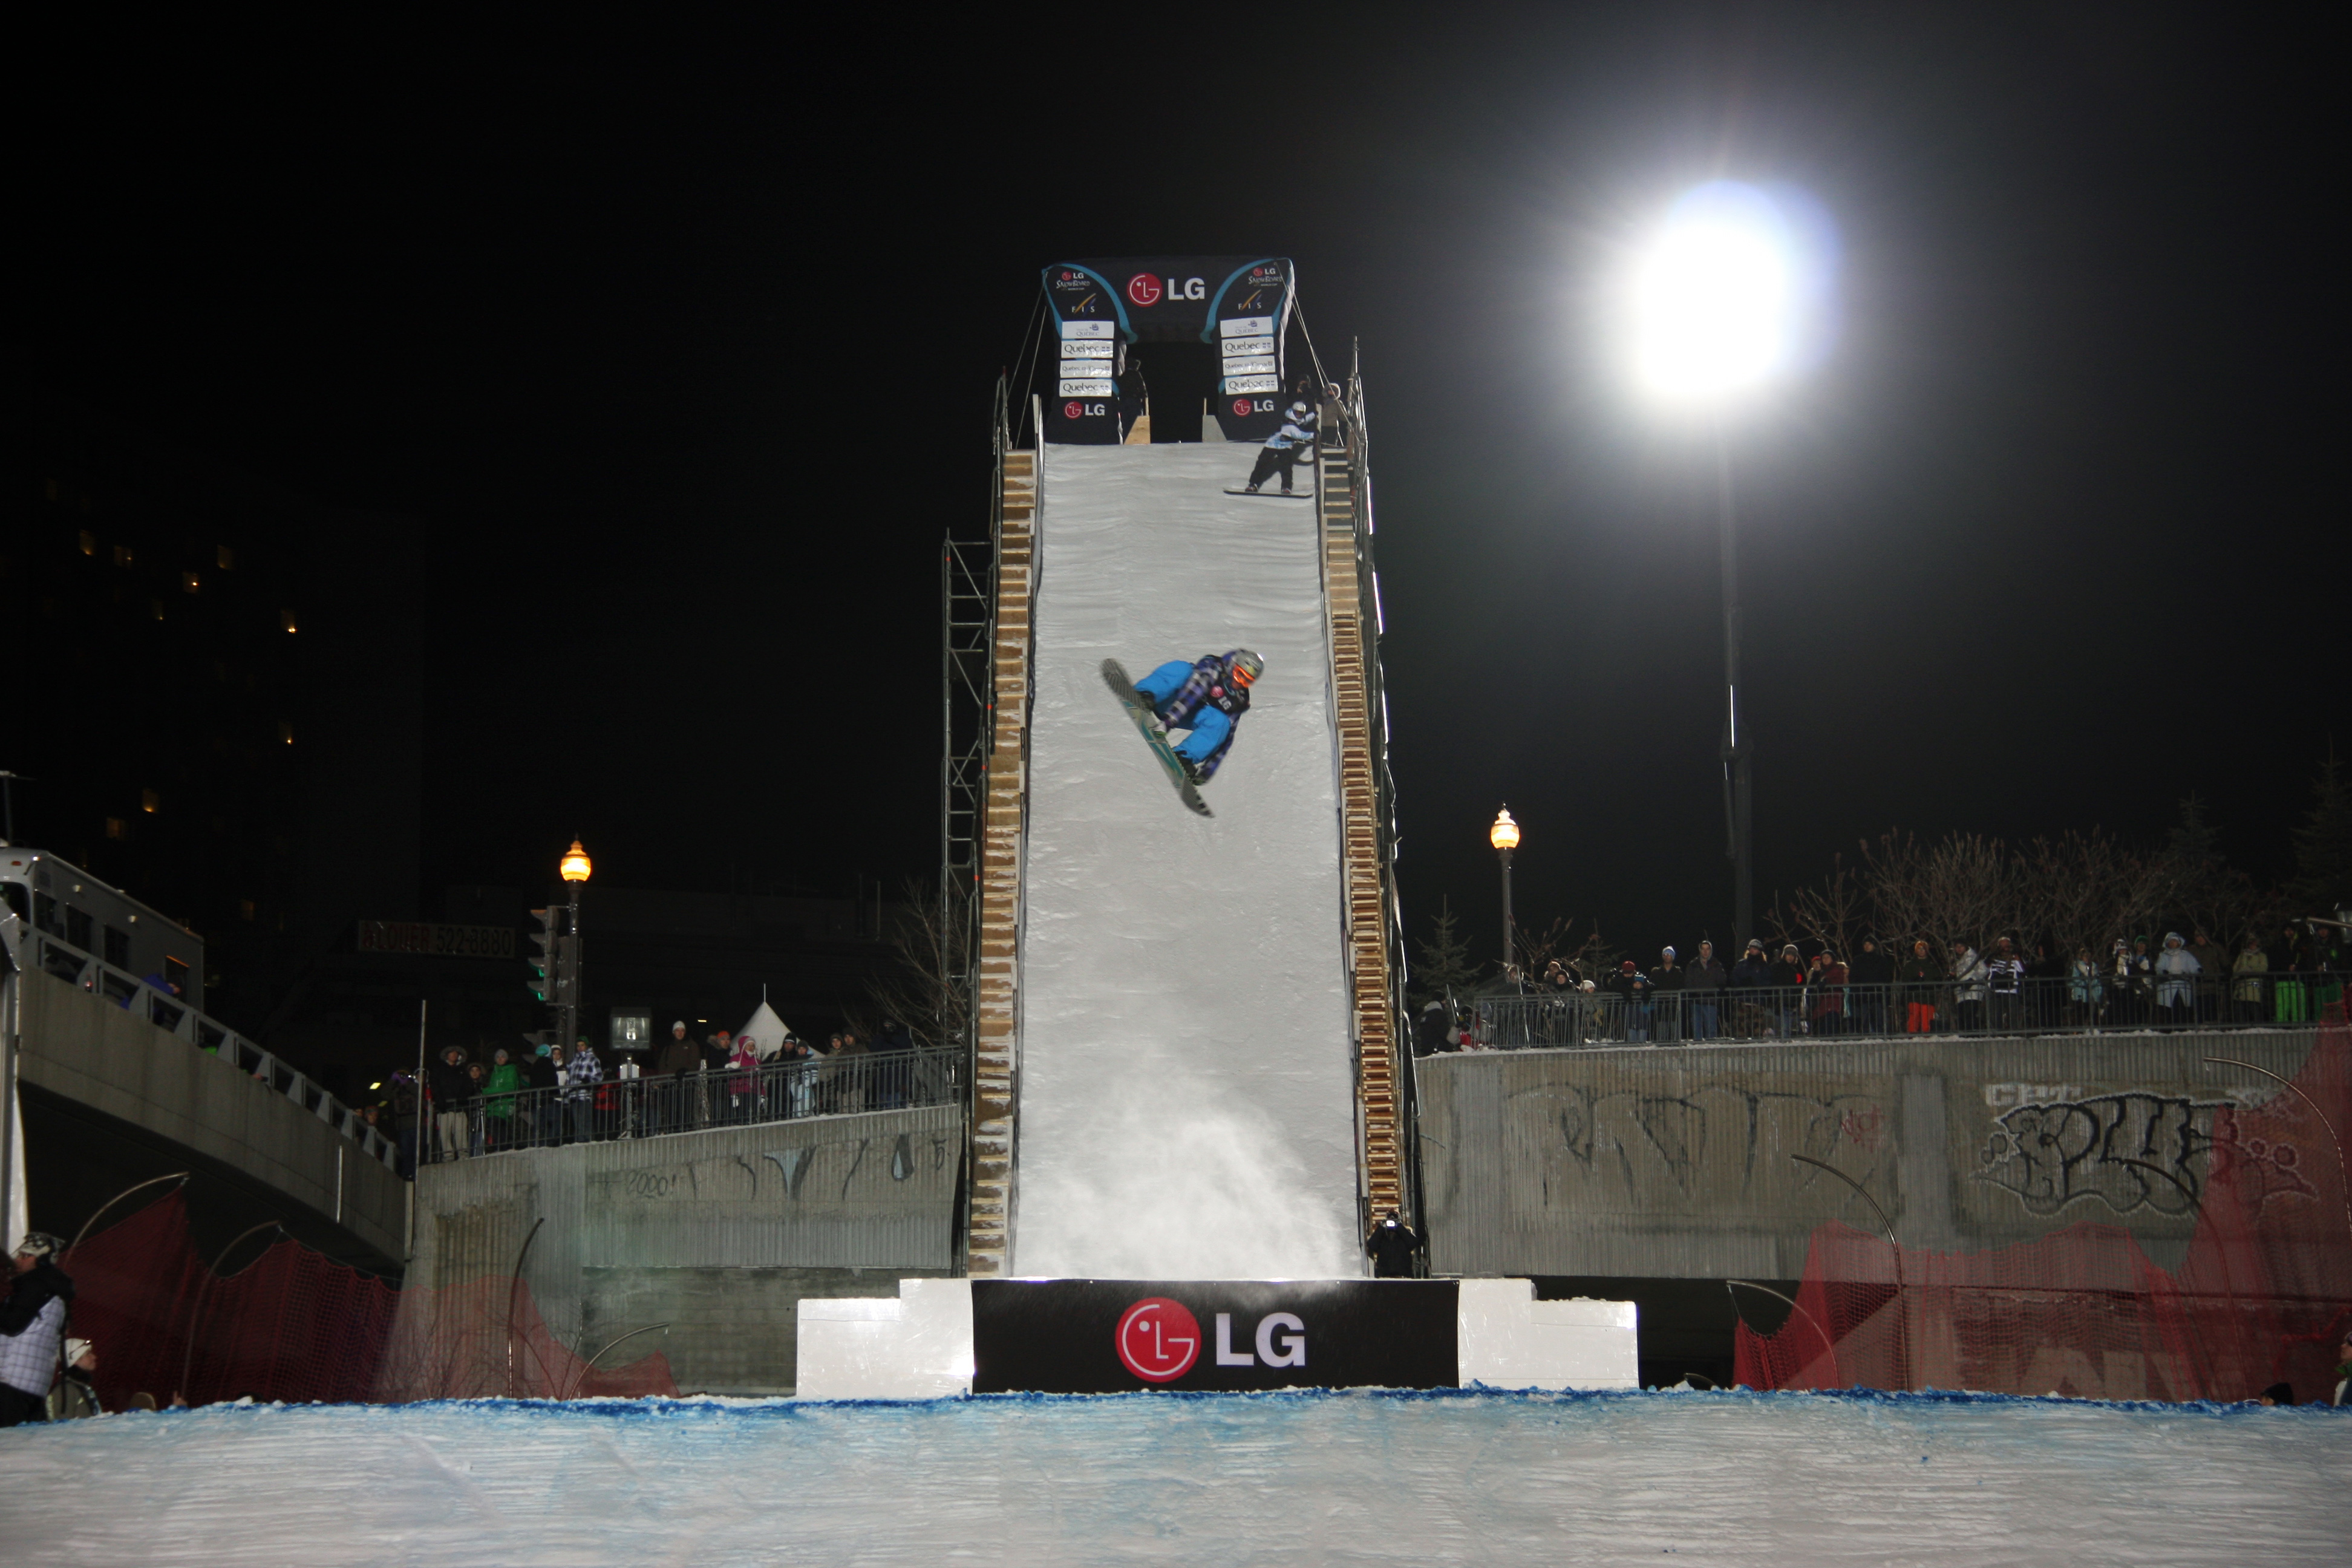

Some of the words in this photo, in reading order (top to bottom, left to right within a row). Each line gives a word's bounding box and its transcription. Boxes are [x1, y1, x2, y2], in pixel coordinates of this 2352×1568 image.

[1168, 278, 1205, 300] LG
[1085, 403, 1105, 416] LG
[1253, 400, 1275, 413] LG
[1215, 1312, 1305, 1368] LG
